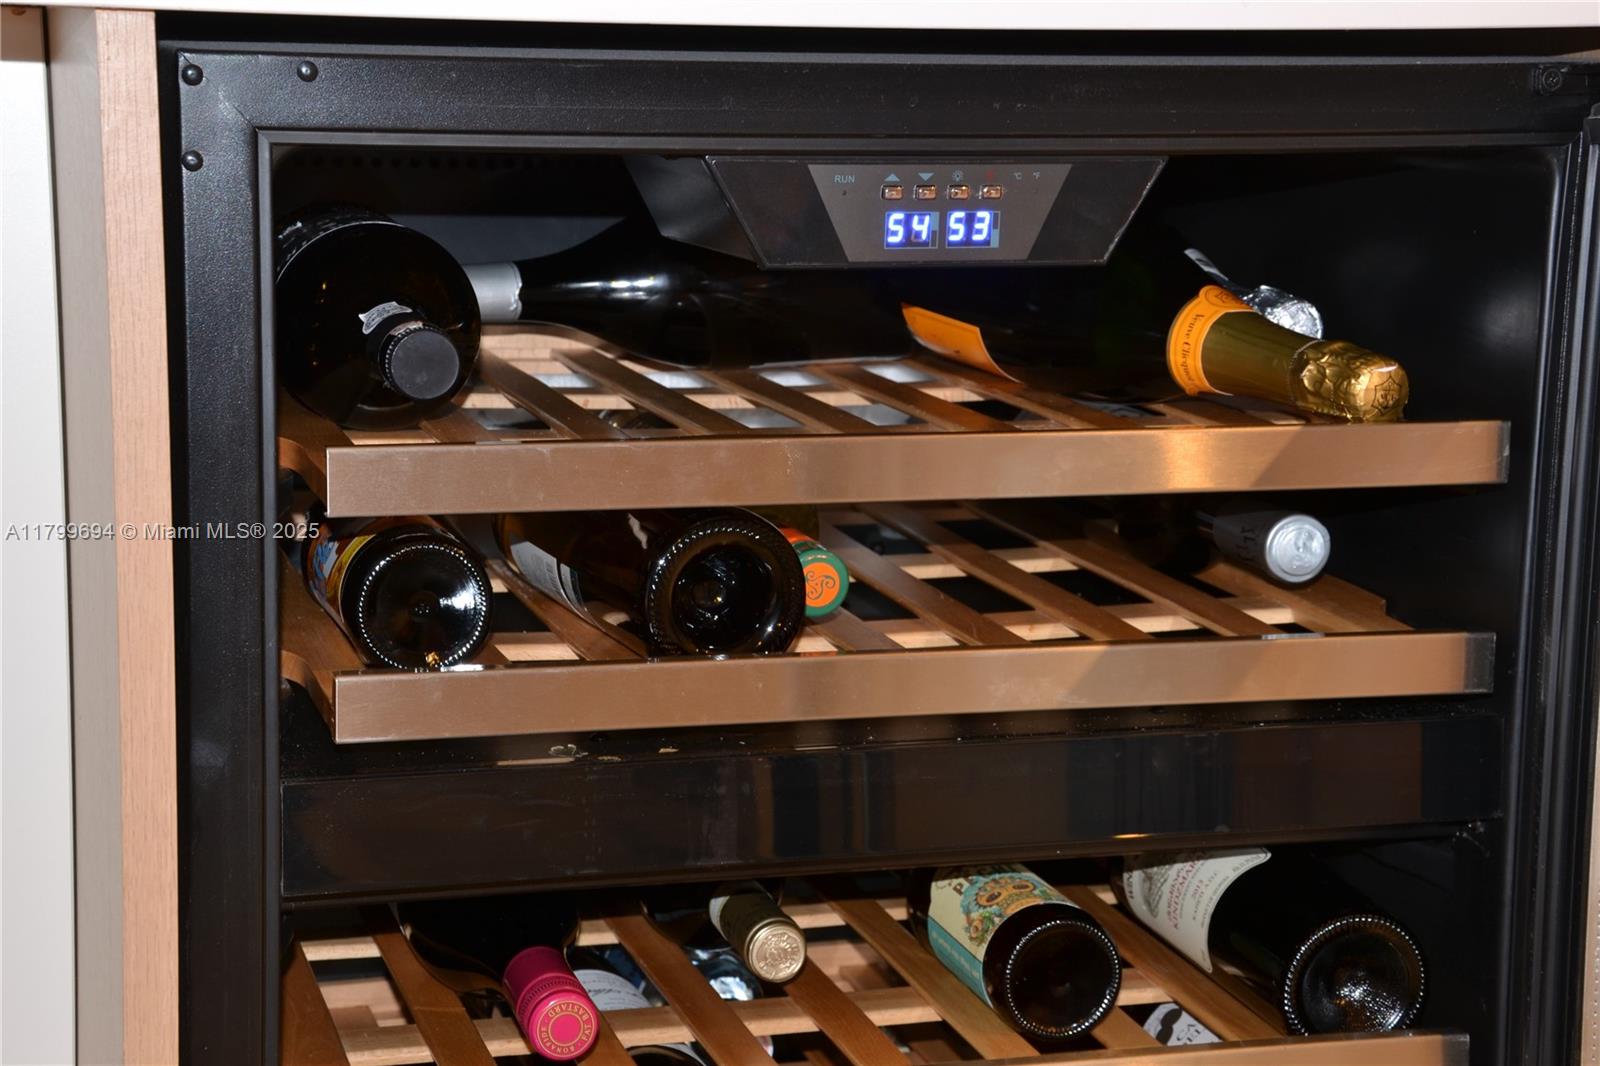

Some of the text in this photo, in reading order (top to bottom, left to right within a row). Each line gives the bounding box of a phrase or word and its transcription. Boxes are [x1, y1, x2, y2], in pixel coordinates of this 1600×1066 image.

[834, 175, 856, 184] RUN
[886, 210, 992, 243] 54 53
[547, 1002, 590, 1020] BASTARD
[580, 1023, 592, 1042] FAT
